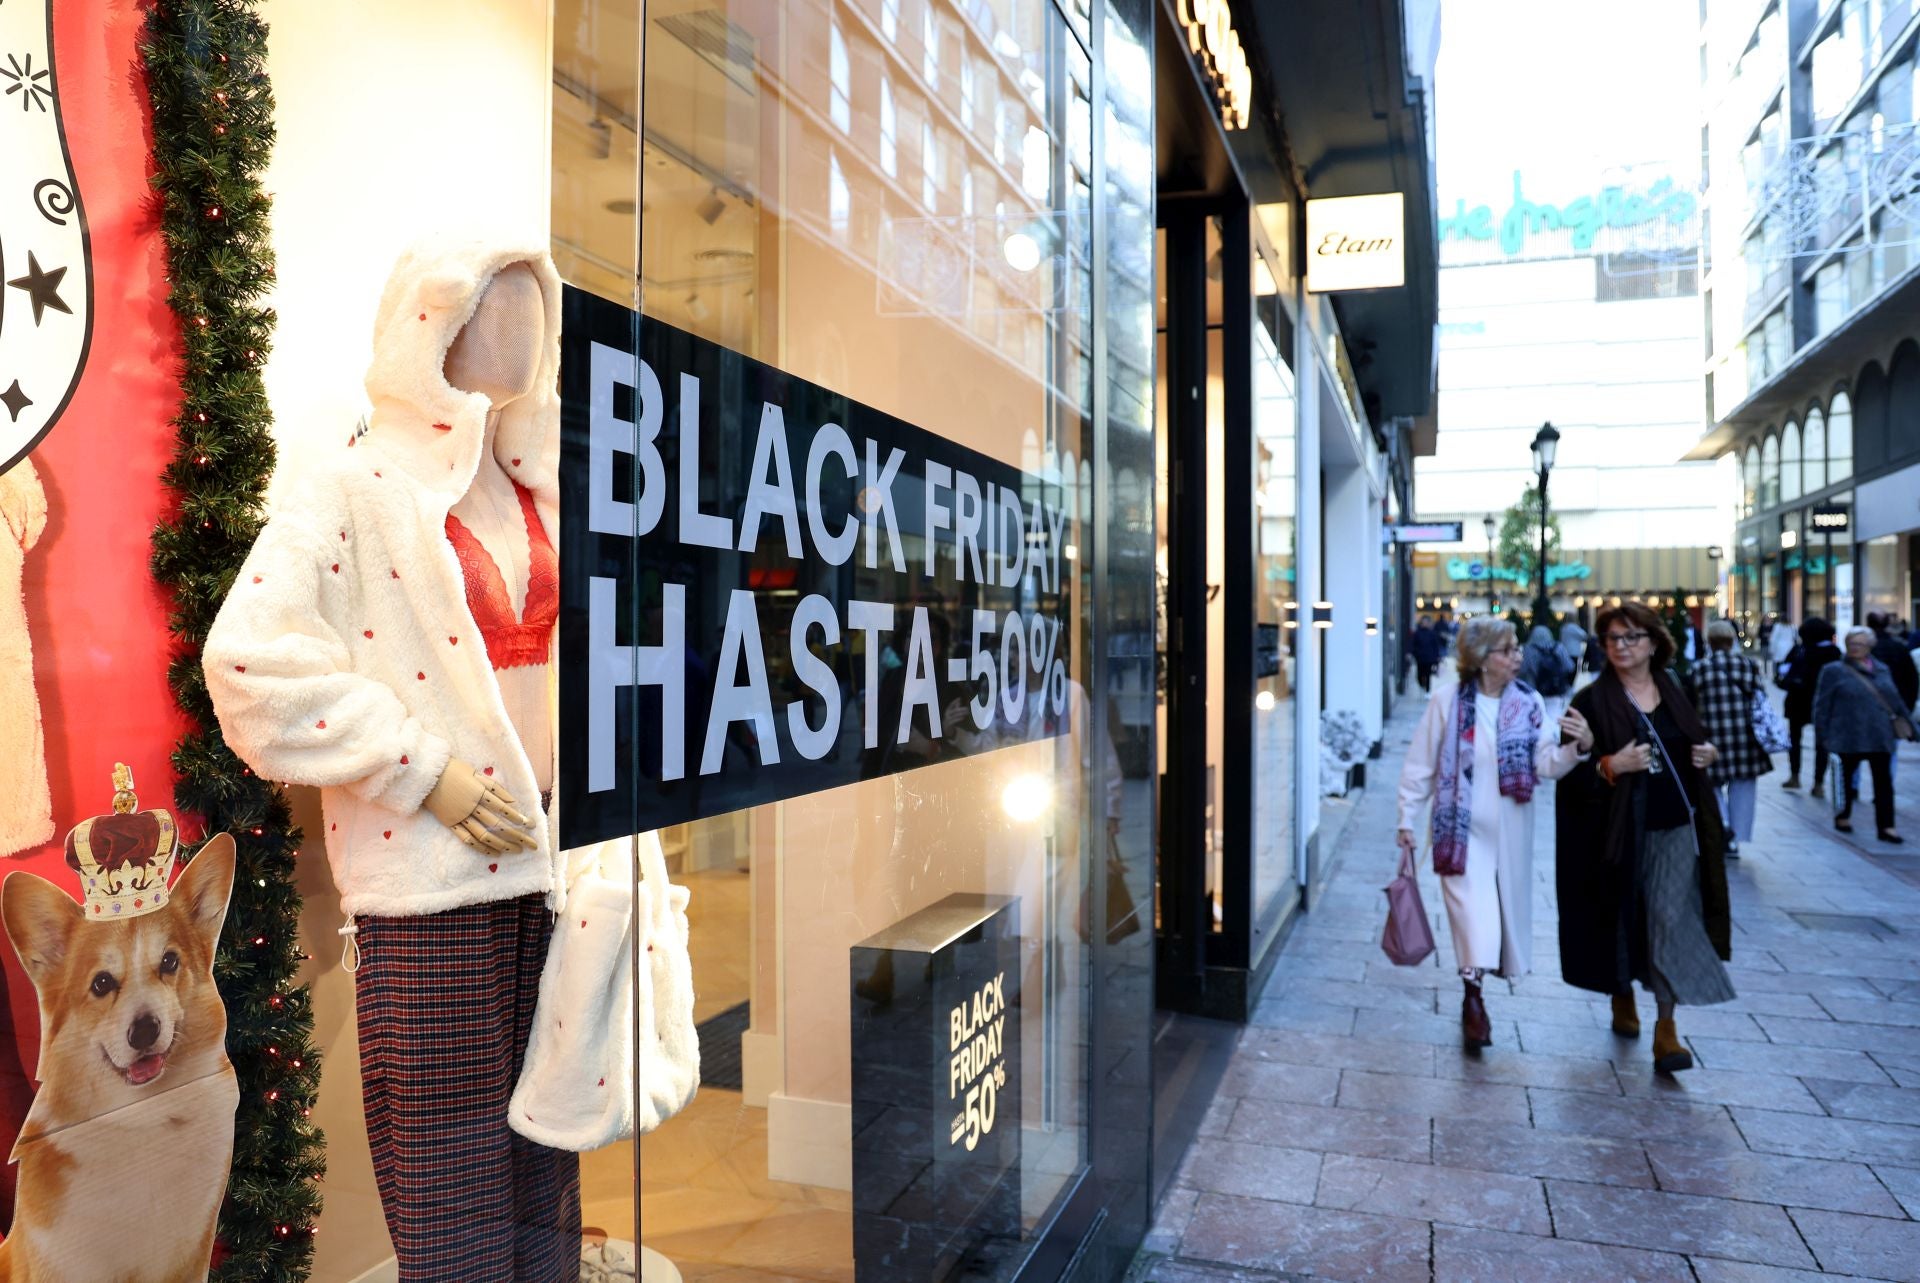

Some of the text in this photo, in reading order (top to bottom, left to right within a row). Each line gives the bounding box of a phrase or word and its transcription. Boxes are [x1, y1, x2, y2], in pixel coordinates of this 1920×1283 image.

[1317, 232, 1393, 256] Etam
[588, 340, 1066, 595] BLACK FRIDAY
[951, 971, 1005, 1052] BLACK
[951, 1015, 1005, 1100] FRIDAY
